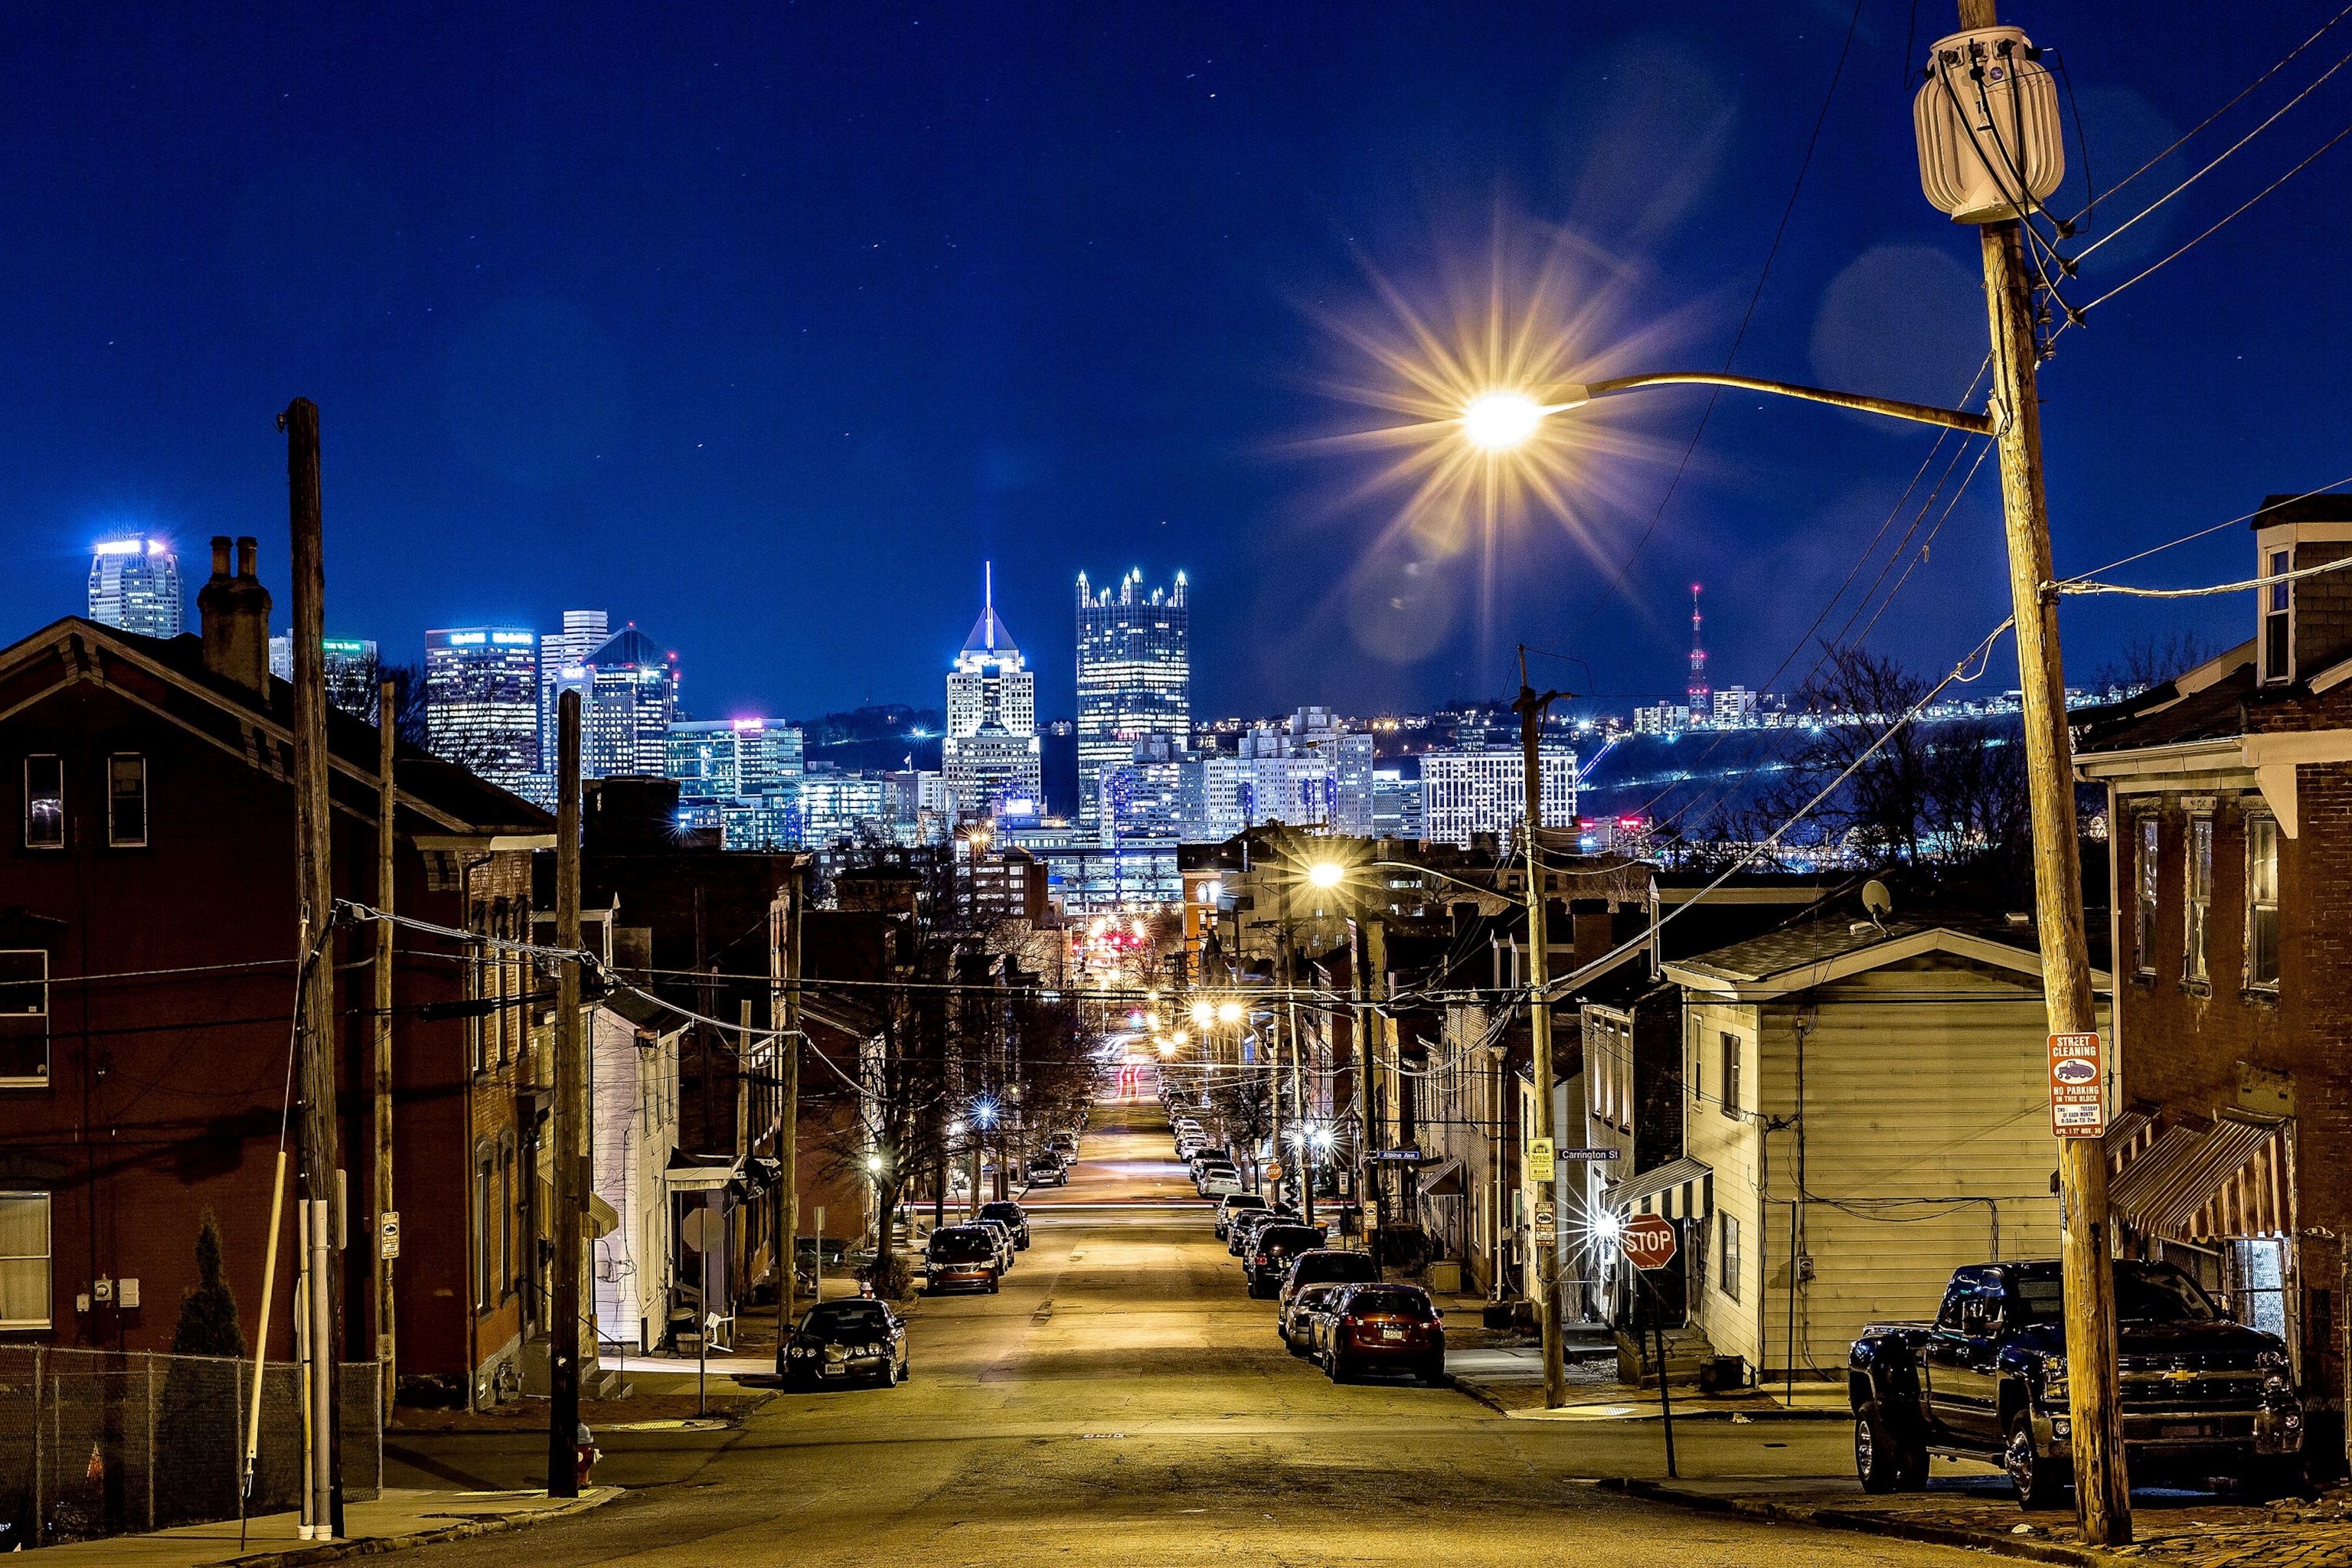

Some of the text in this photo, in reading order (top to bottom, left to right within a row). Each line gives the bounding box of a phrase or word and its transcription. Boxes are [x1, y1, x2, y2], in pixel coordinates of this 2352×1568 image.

[2056, 1036, 2090, 1047] STREET
[2053, 1046, 2096, 1057] CLEANING
[2053, 1086, 2099, 1096] NO PARKING
[1563, 1150, 1619, 1160] Carrington St
[1625, 1230, 1671, 1253] STOP
